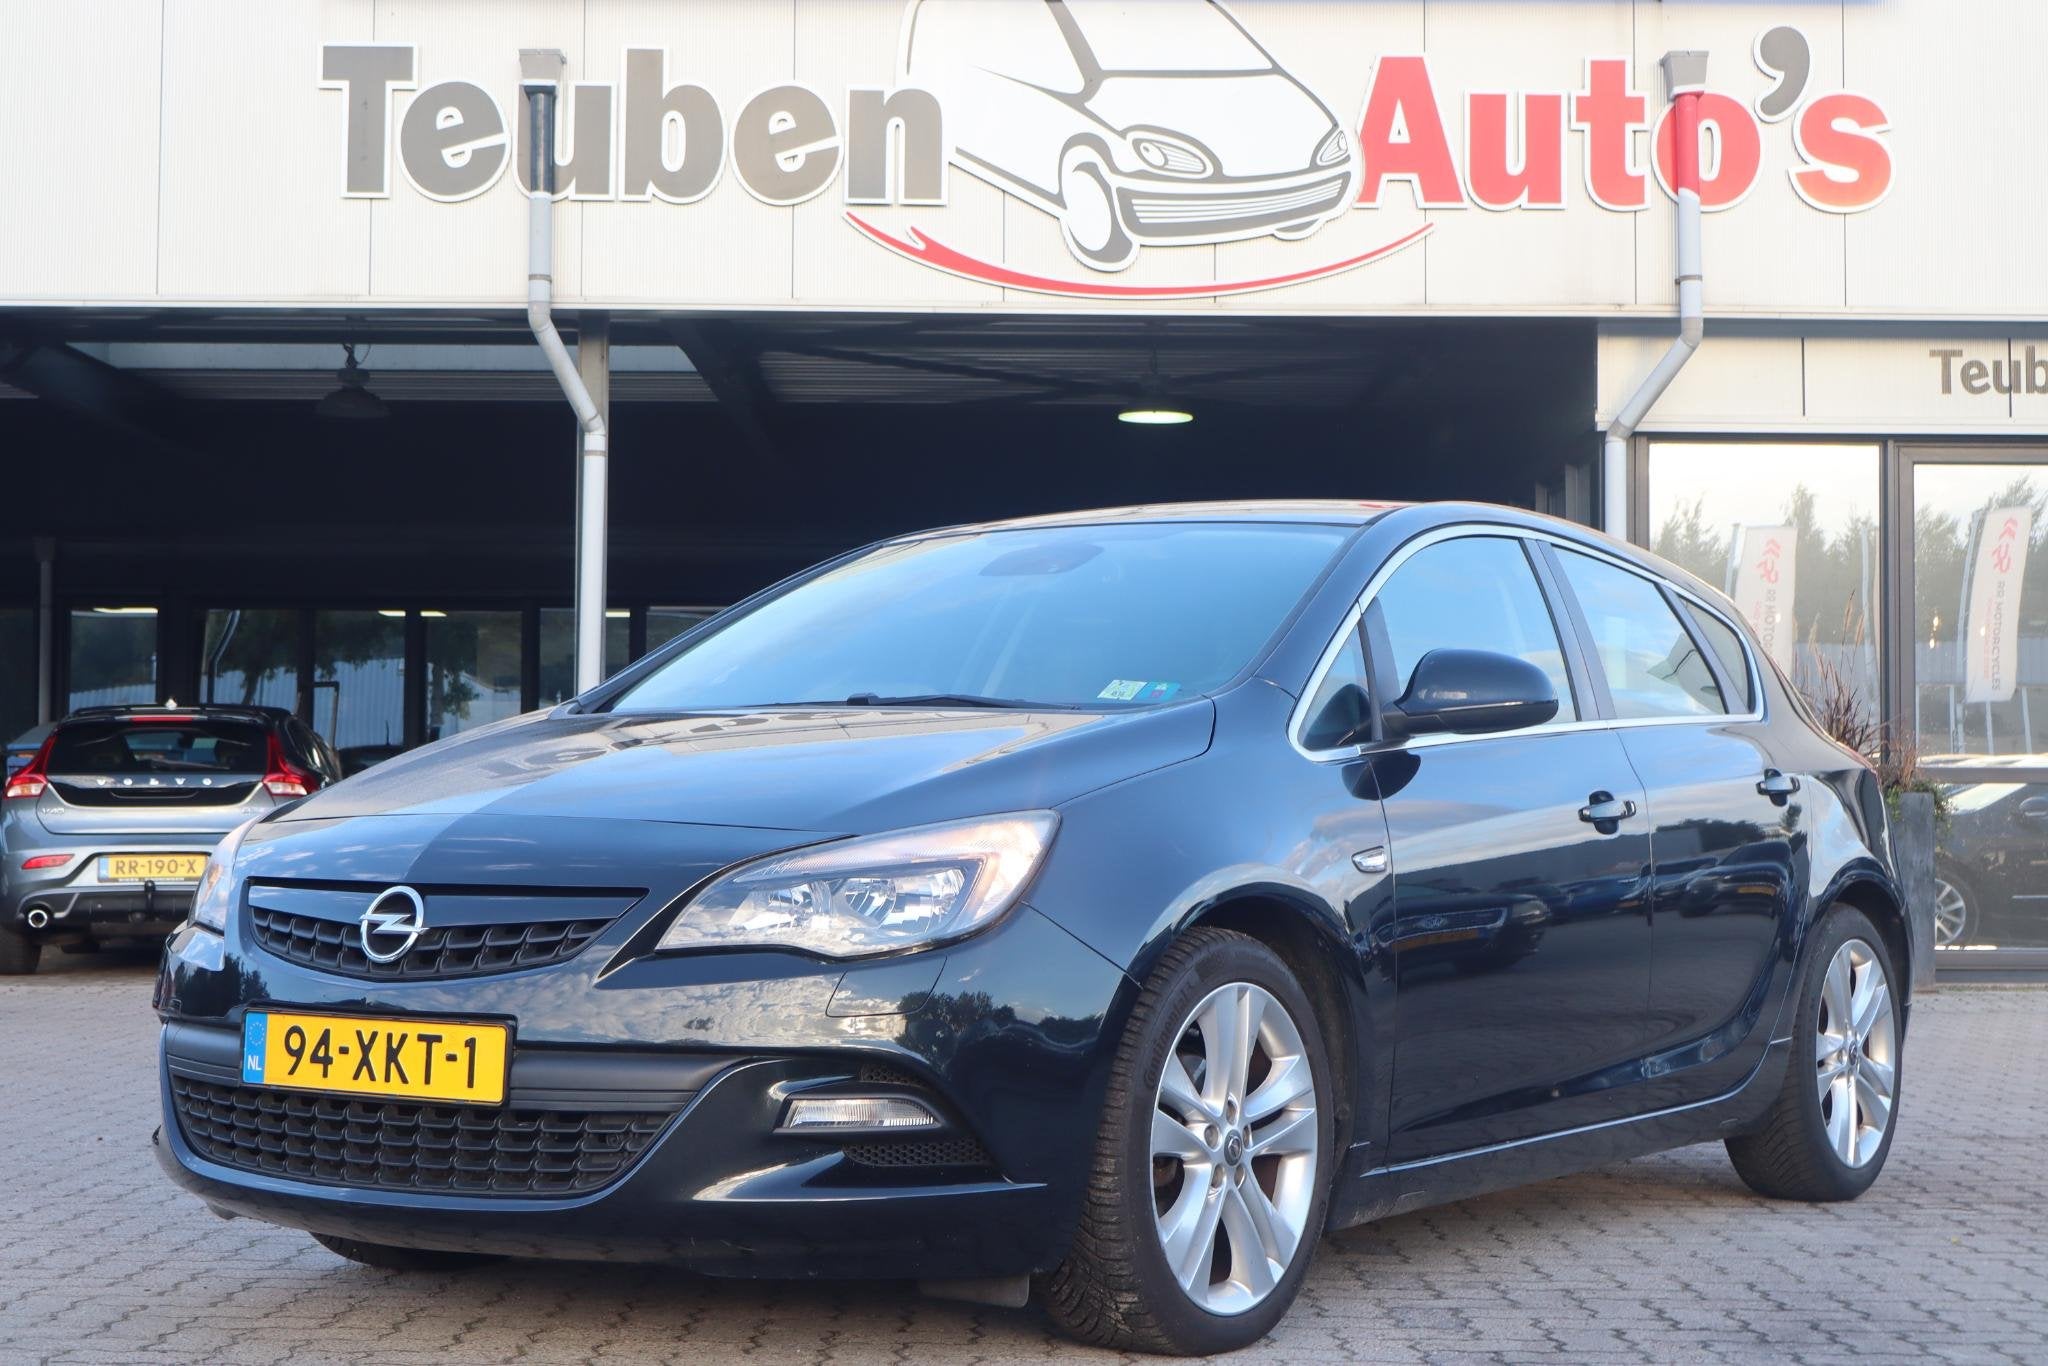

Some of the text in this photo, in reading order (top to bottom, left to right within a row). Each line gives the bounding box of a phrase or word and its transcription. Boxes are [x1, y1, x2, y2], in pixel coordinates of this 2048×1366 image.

[319, 26, 1893, 213] Teuben Auto's
[1929, 345, 2048, 394] Teub
[1991, 602, 2005, 691] MOTORCYCLES
[96, 777, 212, 787] VOLVO
[115, 859, 197, 874] RR-190-X
[247, 1055, 262, 1071] NL
[284, 1025, 477, 1088] 94-XKT-1
